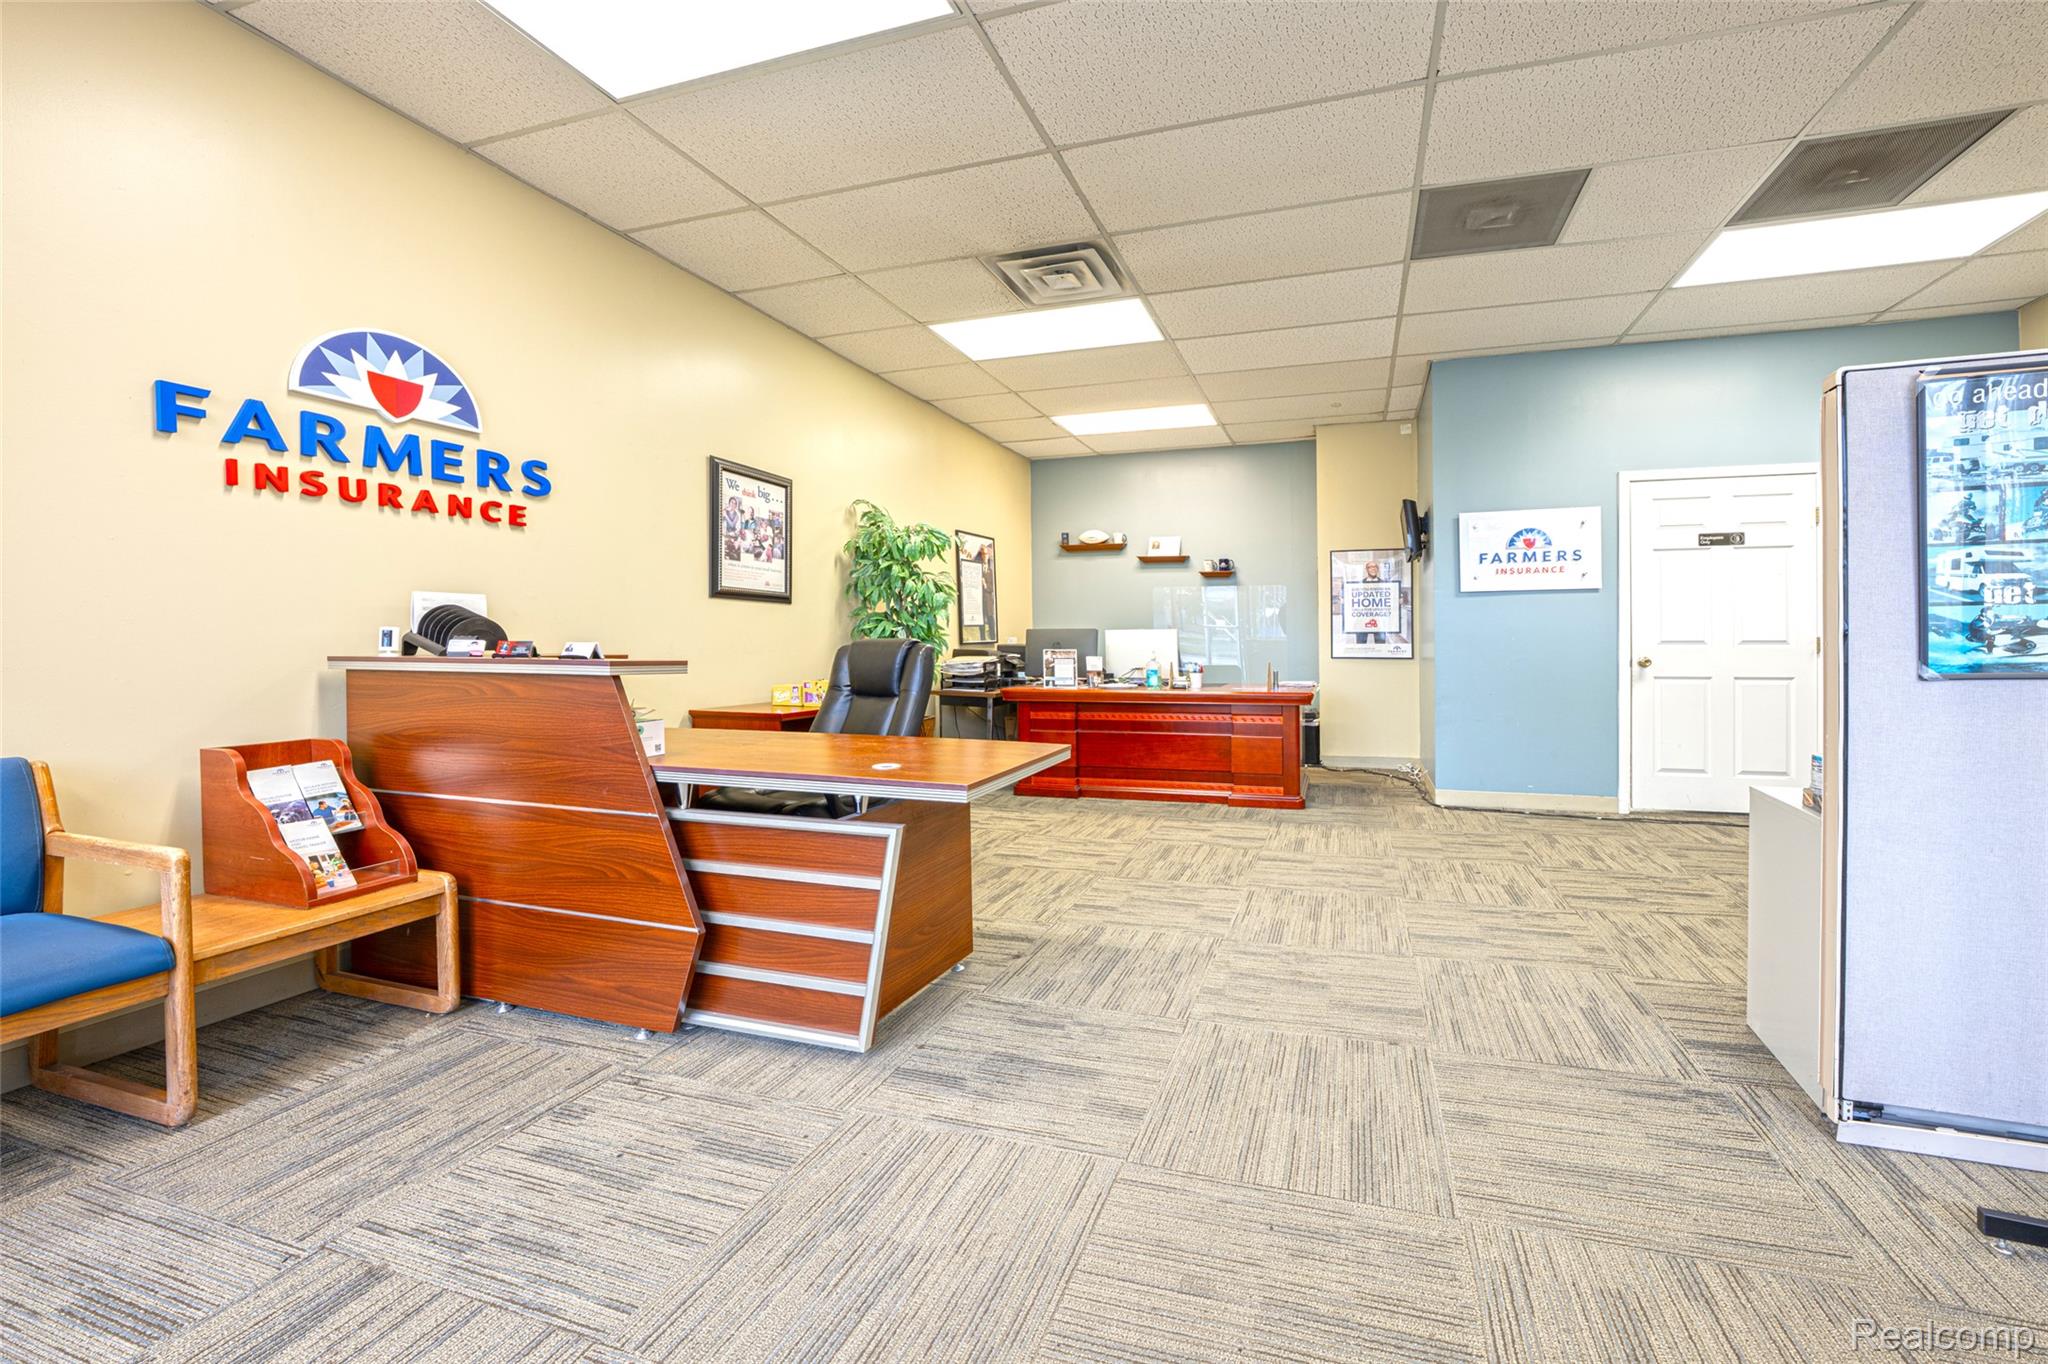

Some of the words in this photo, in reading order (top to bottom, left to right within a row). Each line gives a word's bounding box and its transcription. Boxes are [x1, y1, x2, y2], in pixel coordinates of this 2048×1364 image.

[1973, 378, 2048, 403] ahead
[154, 380, 552, 497] FARMERS
[225, 458, 527, 527] INSURANCE
[726, 478, 740, 491] We
[1479, 549, 1582, 565] FARMERS
[1495, 566, 1565, 576] INSURANCE
[1351, 598, 1391, 607] HOME
